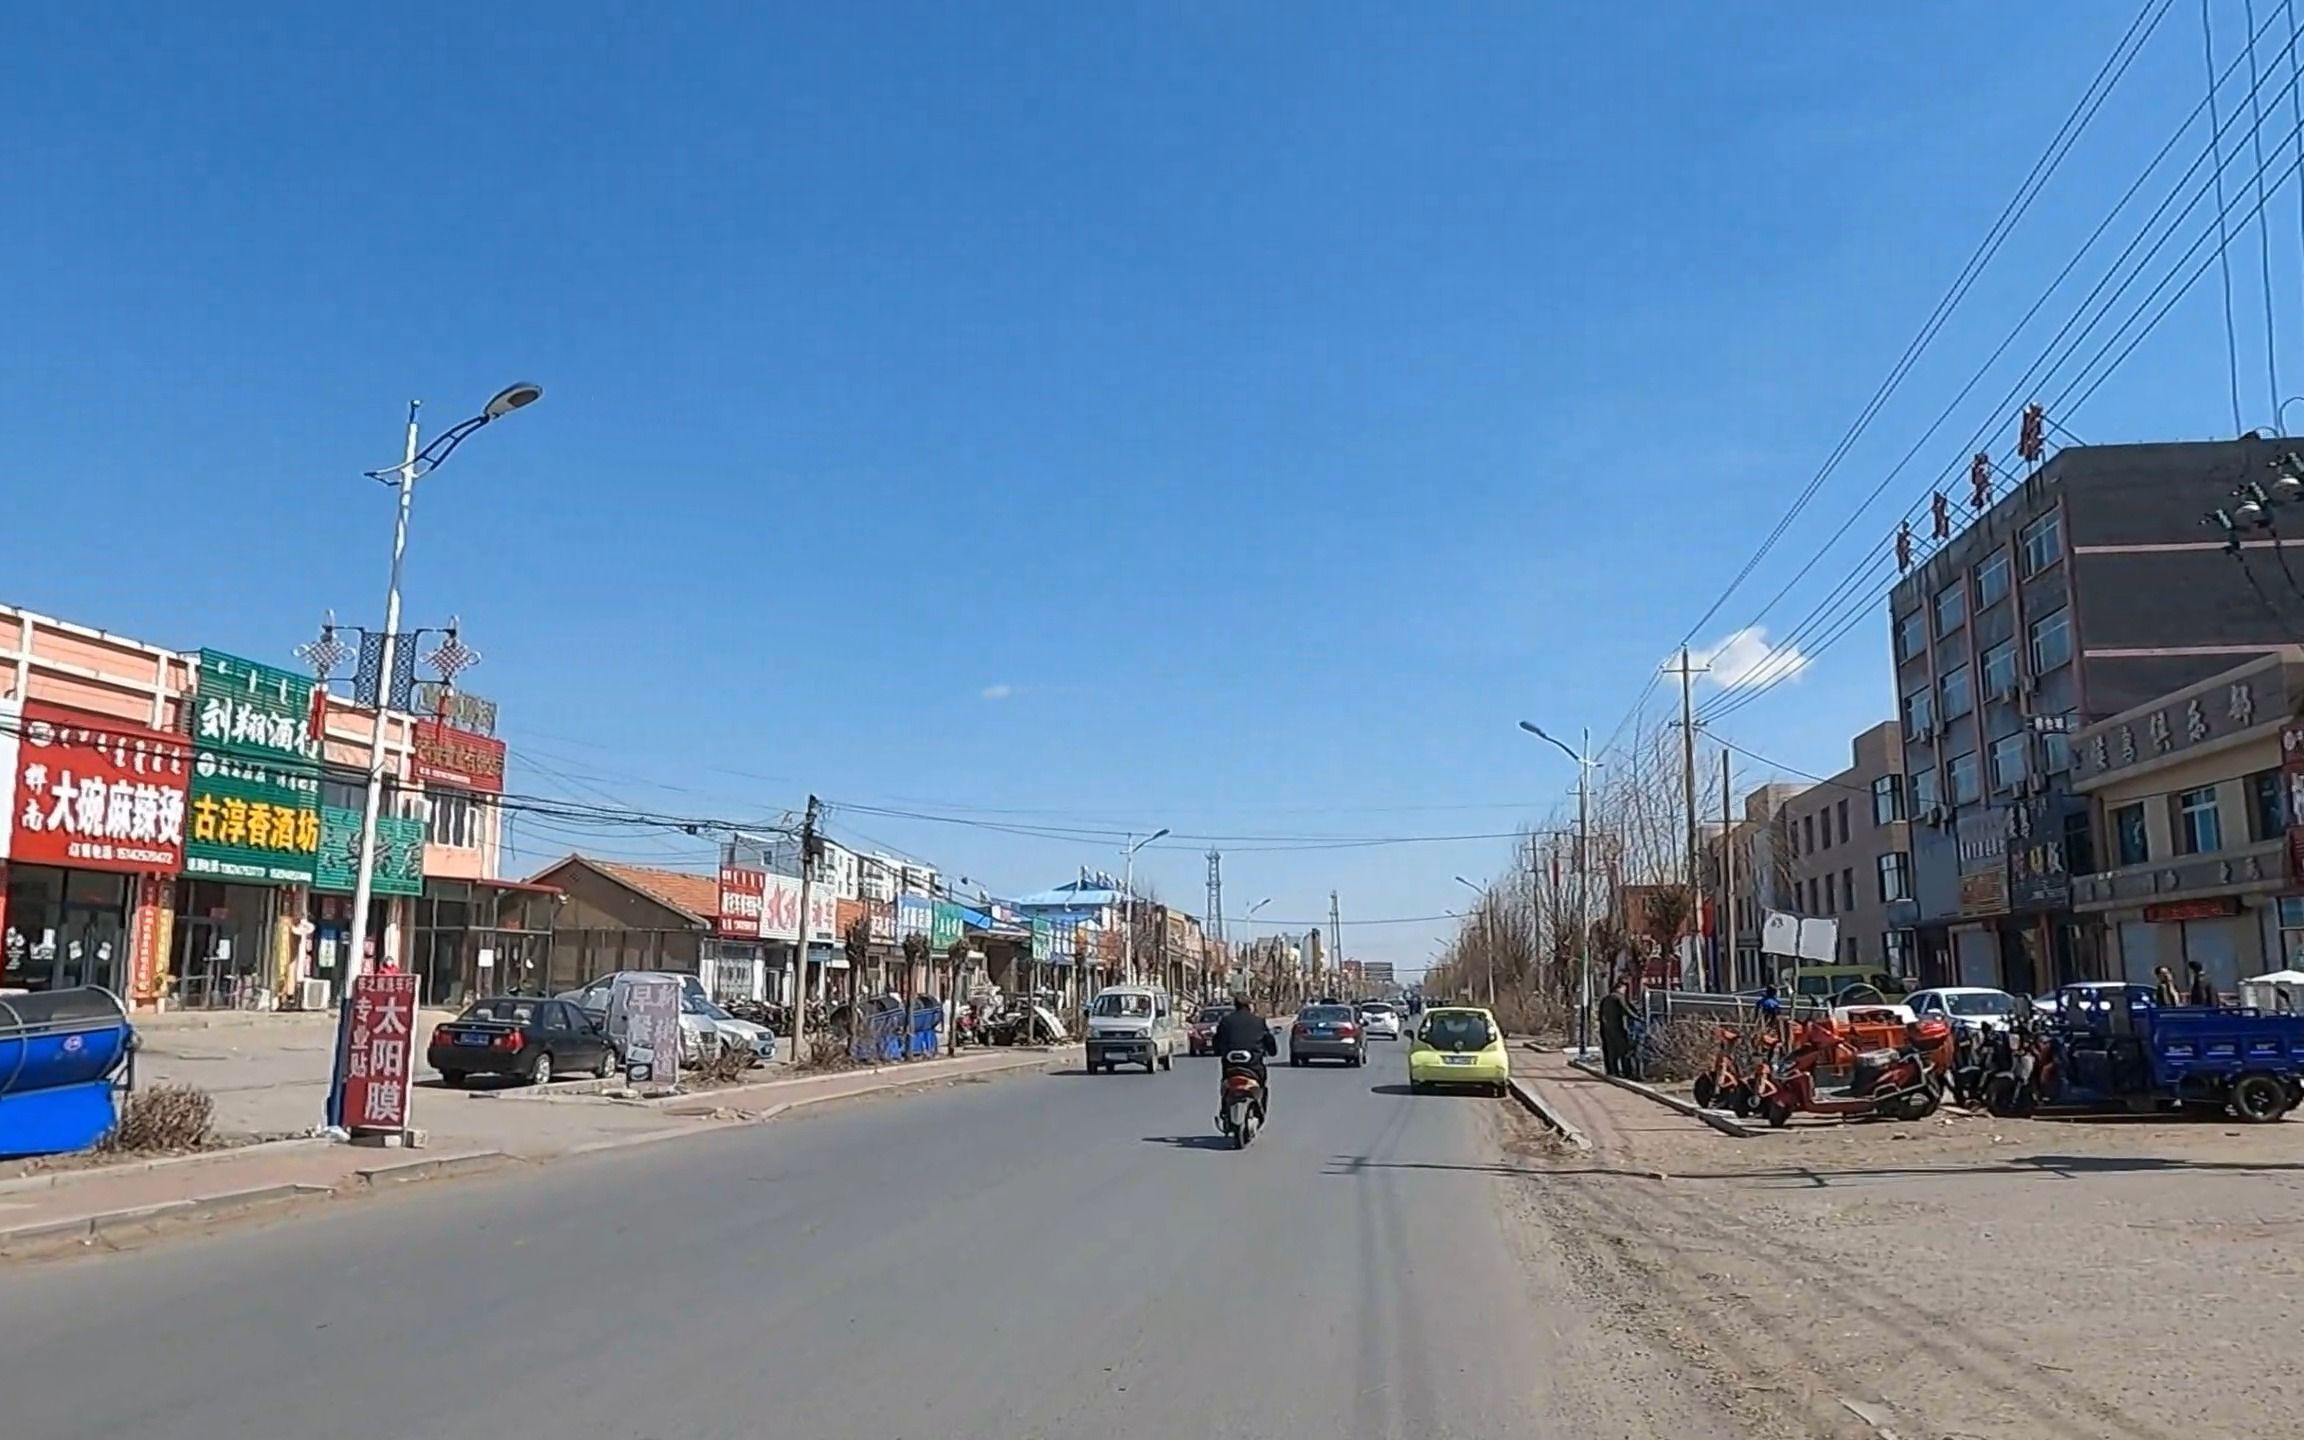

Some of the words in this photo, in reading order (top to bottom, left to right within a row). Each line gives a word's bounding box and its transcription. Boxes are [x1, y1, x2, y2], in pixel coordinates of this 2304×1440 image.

[201, 698, 318, 759] 刘翔酒行
[48, 770, 185, 846] 大碗麻辣烫
[194, 793, 319, 852] 古淳香酒坊
[349, 996, 373, 1078] 专业贴
[364, 996, 407, 1121] 太阳膜
